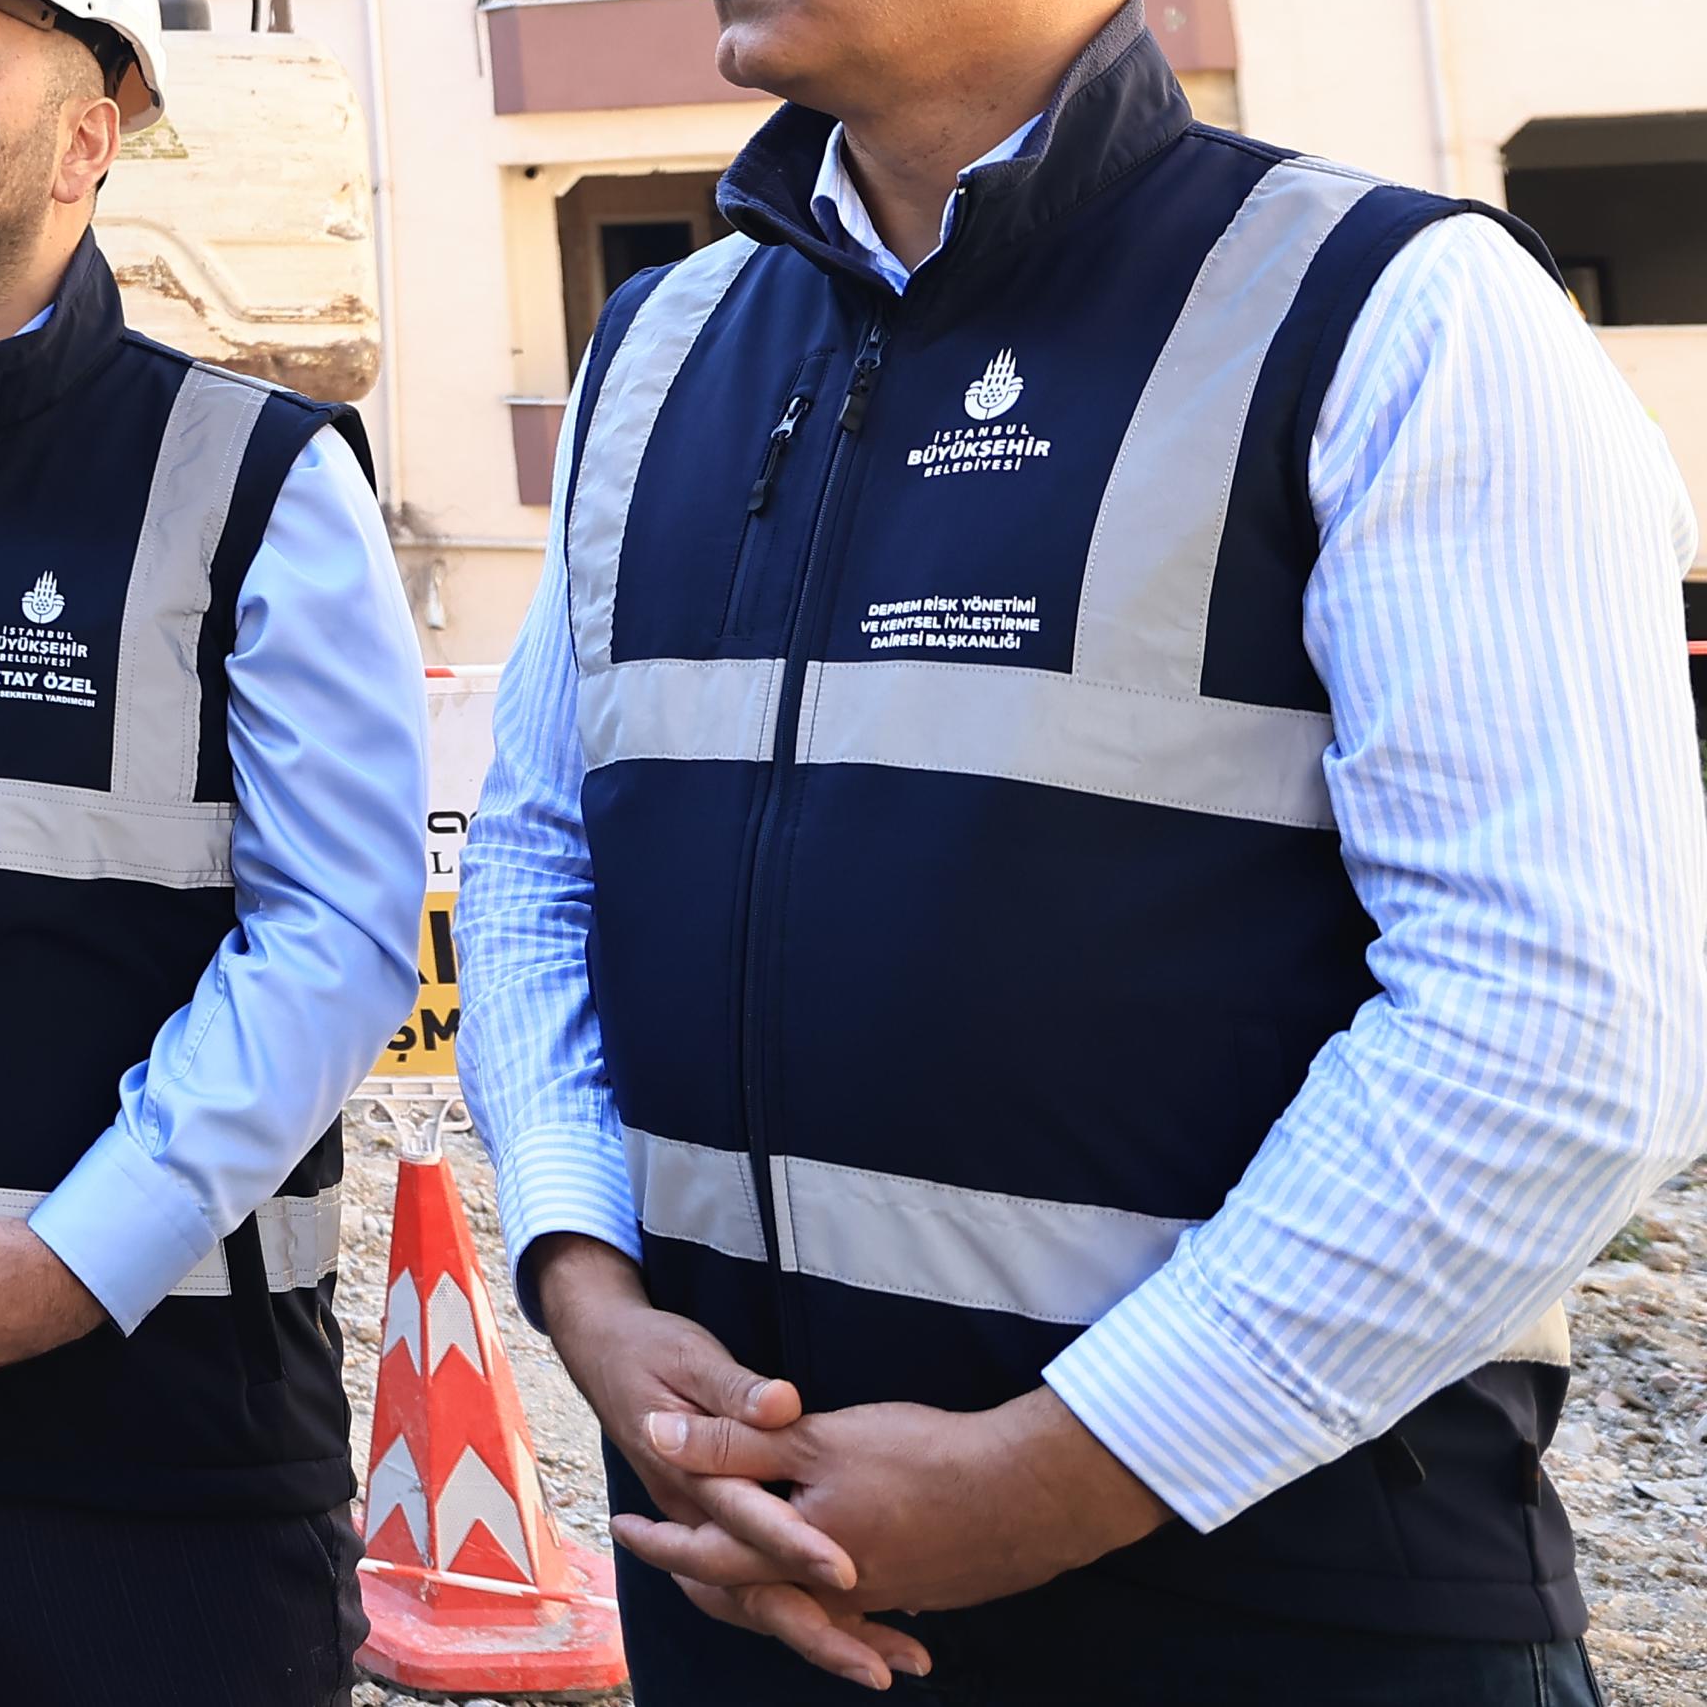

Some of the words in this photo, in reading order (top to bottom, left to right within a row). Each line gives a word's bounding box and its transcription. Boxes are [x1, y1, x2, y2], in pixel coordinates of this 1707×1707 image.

[934, 423, 1029, 444] İSTANBUL
[907, 436, 1051, 465] BÜYÜKŞEHİR
[923, 457, 1022, 478] BELEDİYESİ
[868, 599, 921, 616] DEPREM
[923, 595, 959, 612] RİSK
[961, 595, 1036, 613] YÖNETİMİ
[2, 625, 74, 641] İSTANBUL
[860, 620, 879, 633] VE
[880, 616, 942, 632] KENTSEL
[944, 612, 1041, 632] İYİLEŞTİRME
[870, 630, 924, 649] DAİRESİ
[925, 632, 1021, 650] BAŞKANLIĞI
[0, 653, 71, 668] BELEDİYESİ
[43, 671, 97, 695] ÖZEL
[0, 690, 44, 701] SEKRETER
[45, 694, 95, 708] YARDIMCISI
